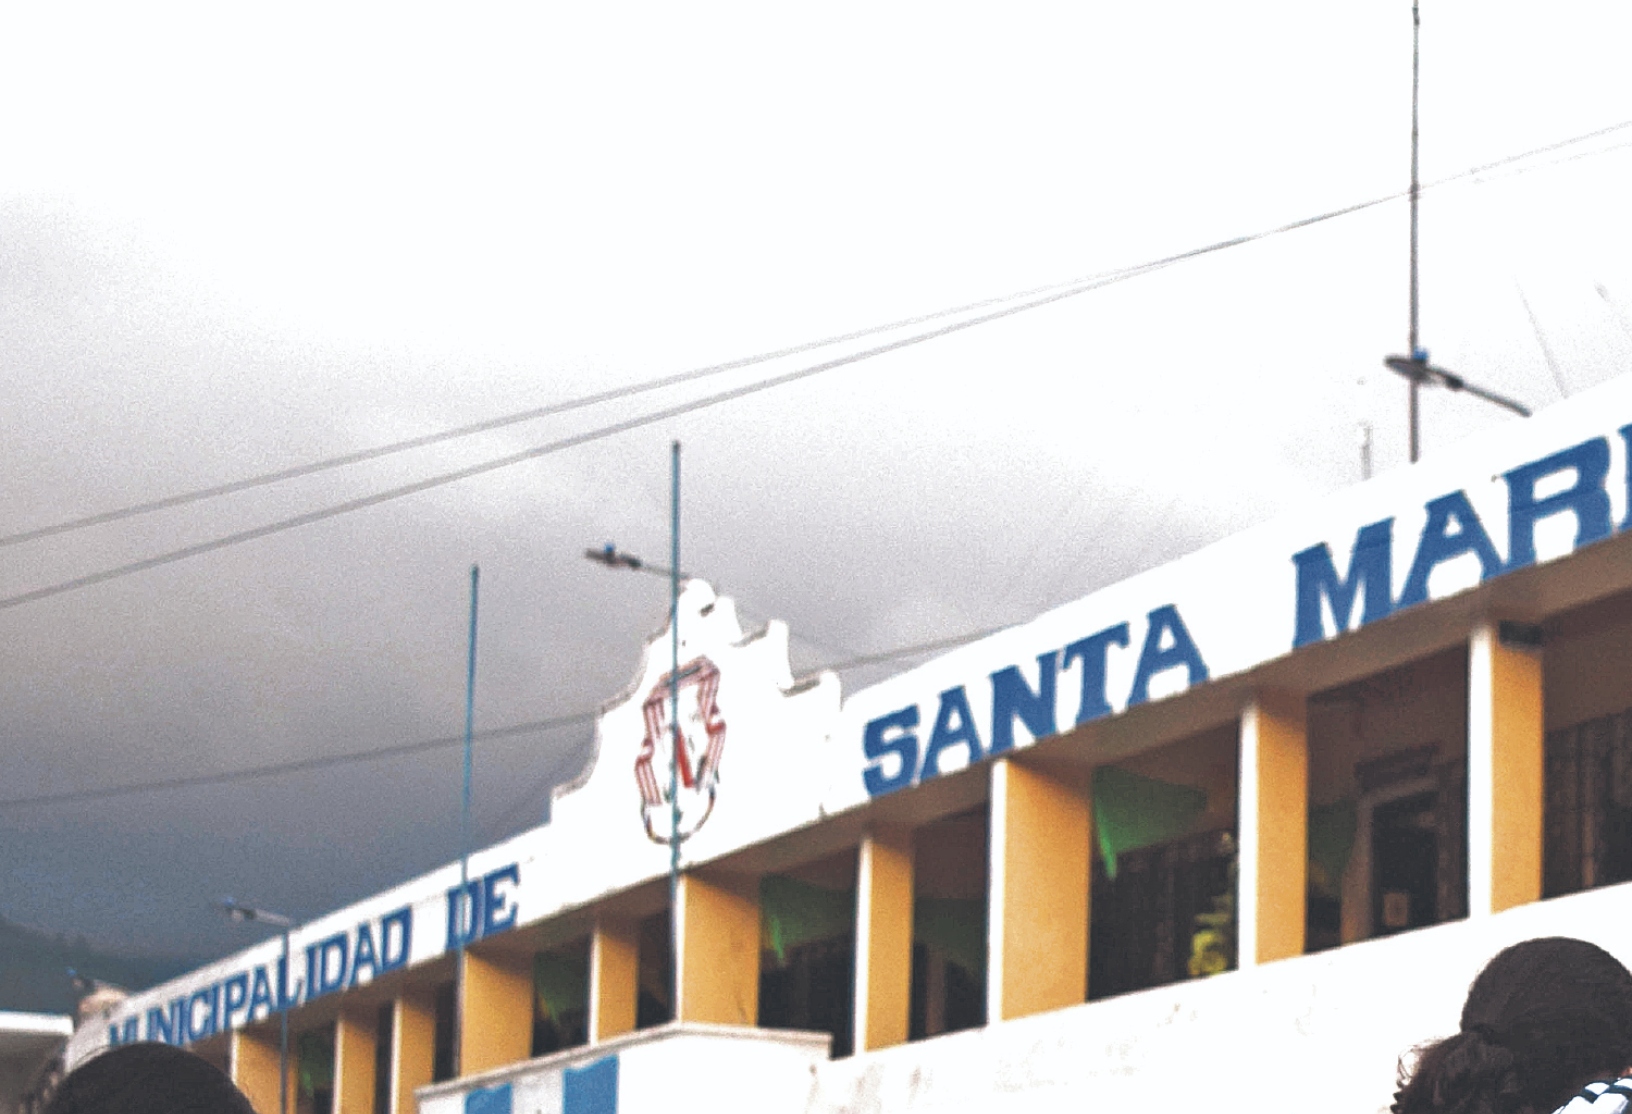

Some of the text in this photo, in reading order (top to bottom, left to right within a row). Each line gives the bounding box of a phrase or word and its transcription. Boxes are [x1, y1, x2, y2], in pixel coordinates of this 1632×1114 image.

[108, 904, 413, 1048] MUNICIPALIDAD
[446, 862, 520, 951] DE
[861, 603, 1211, 797] SANTA
